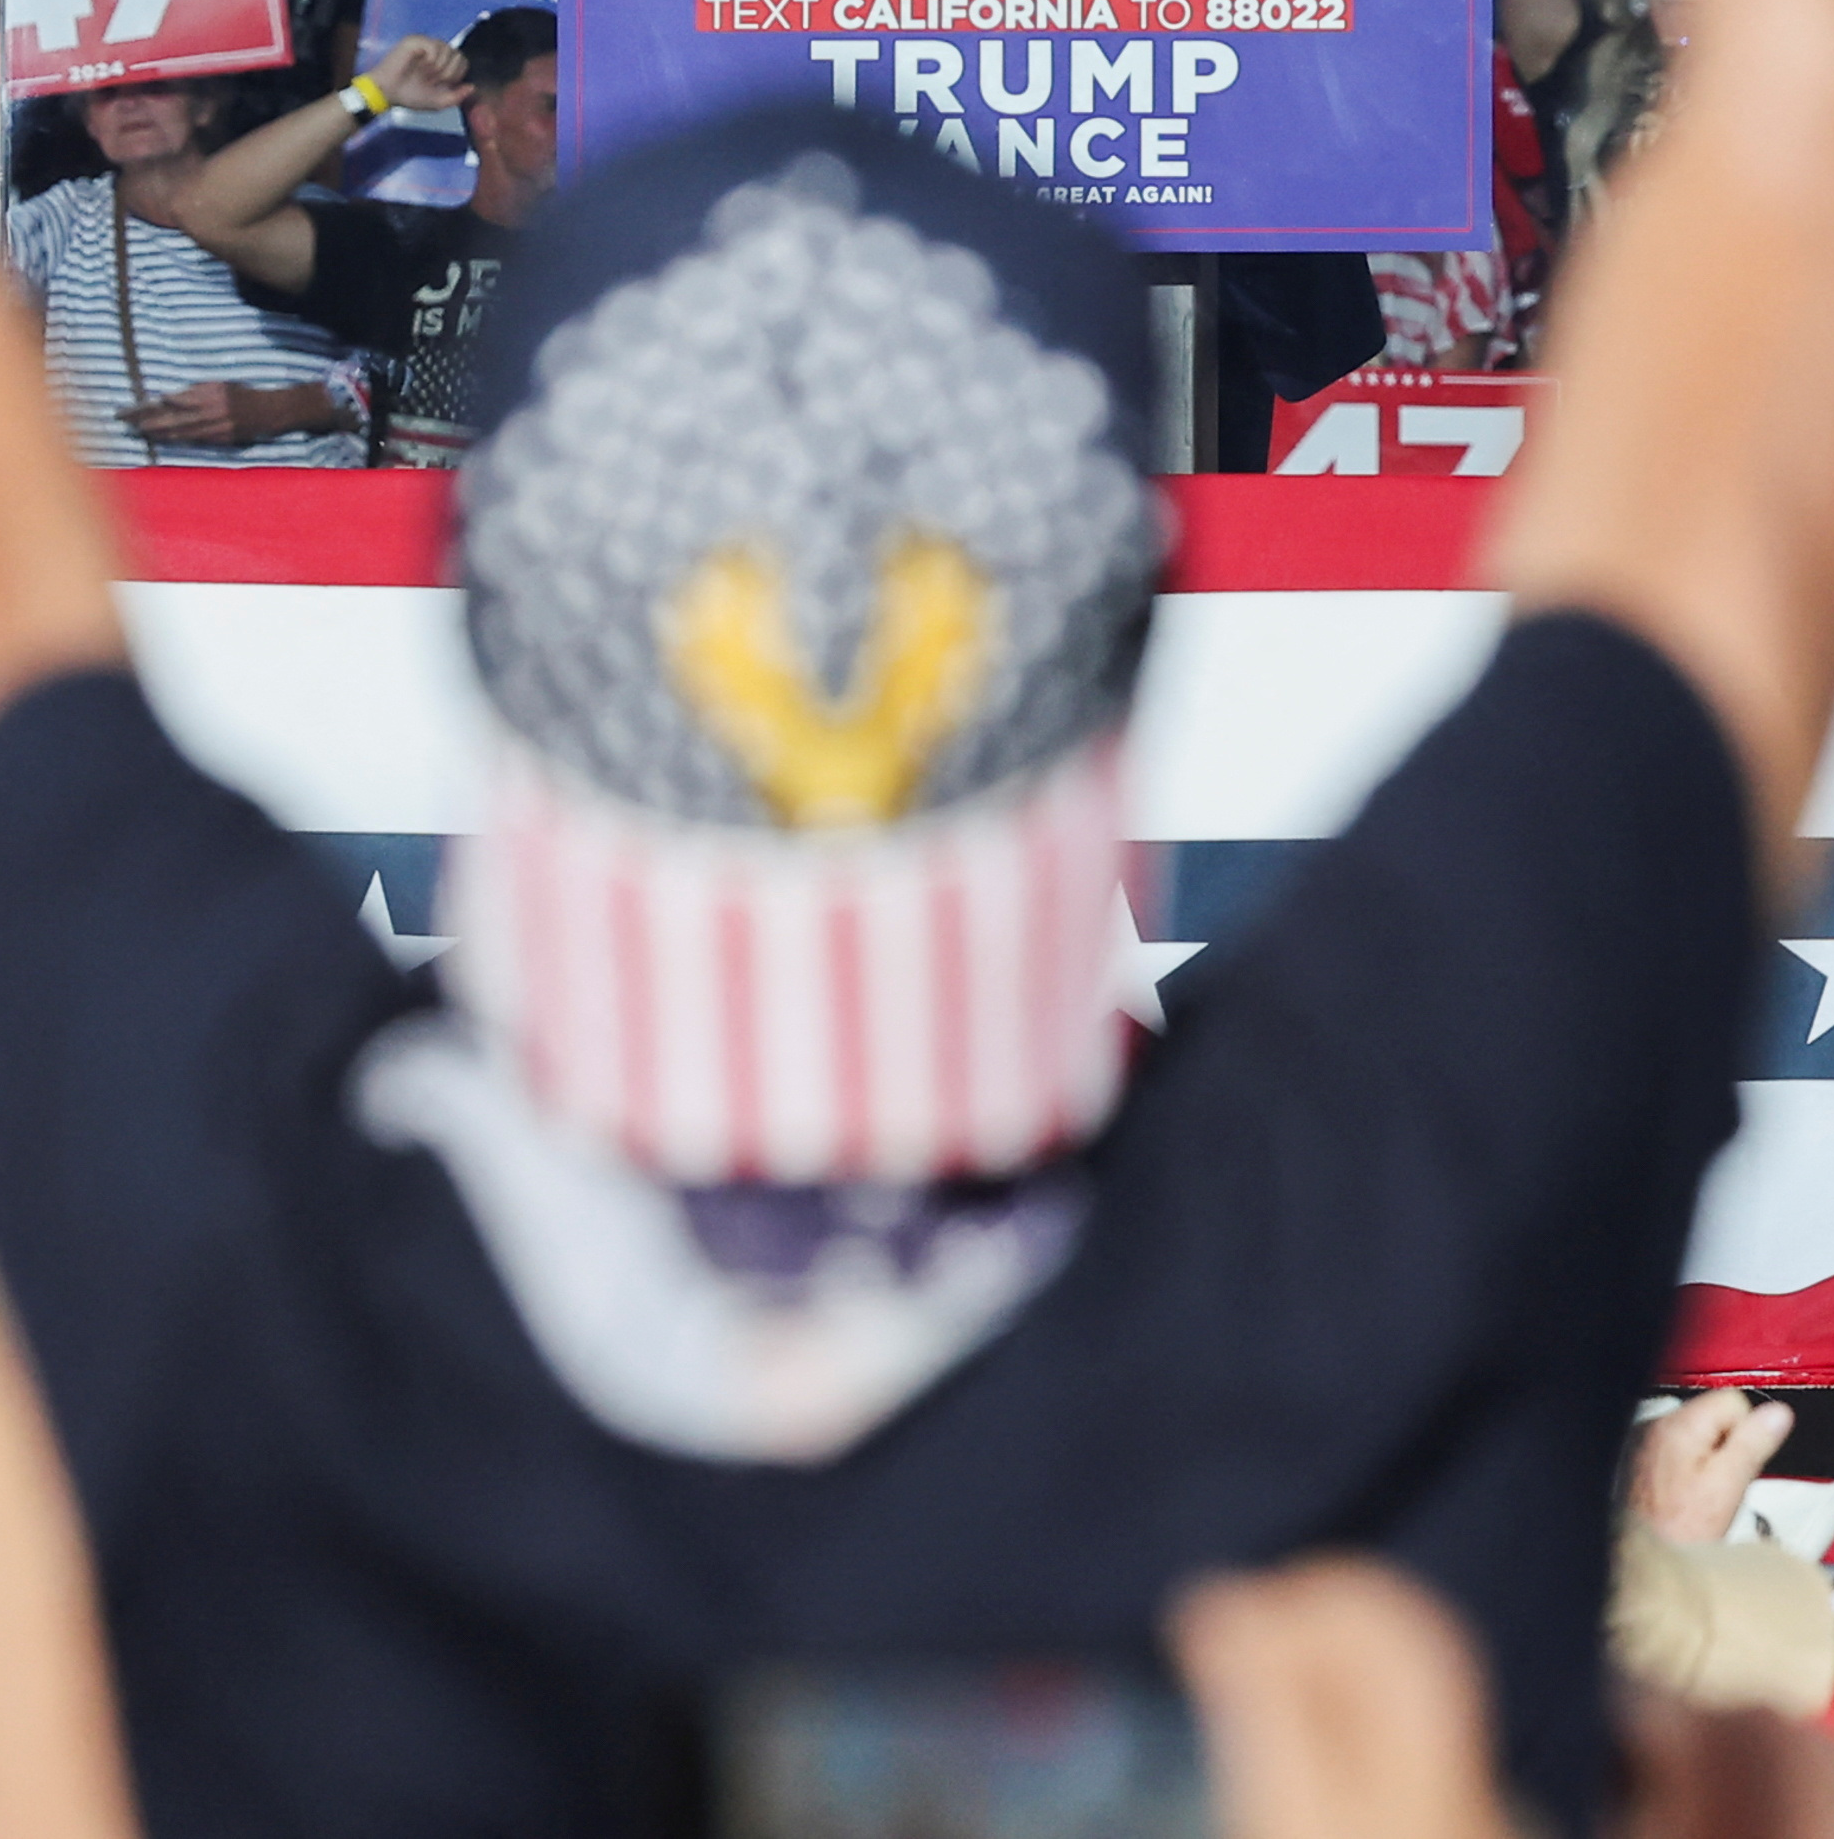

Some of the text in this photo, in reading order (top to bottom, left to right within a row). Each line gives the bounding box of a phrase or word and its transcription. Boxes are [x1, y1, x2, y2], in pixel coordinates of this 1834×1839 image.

[67, 61, 126, 85] 2024
[810, 38, 1239, 115] TRUMP
[898, 118, 1191, 178] ANCE
[1124, 186, 1214, 205] AGAIN!
[412, 303, 484, 337] IS M
